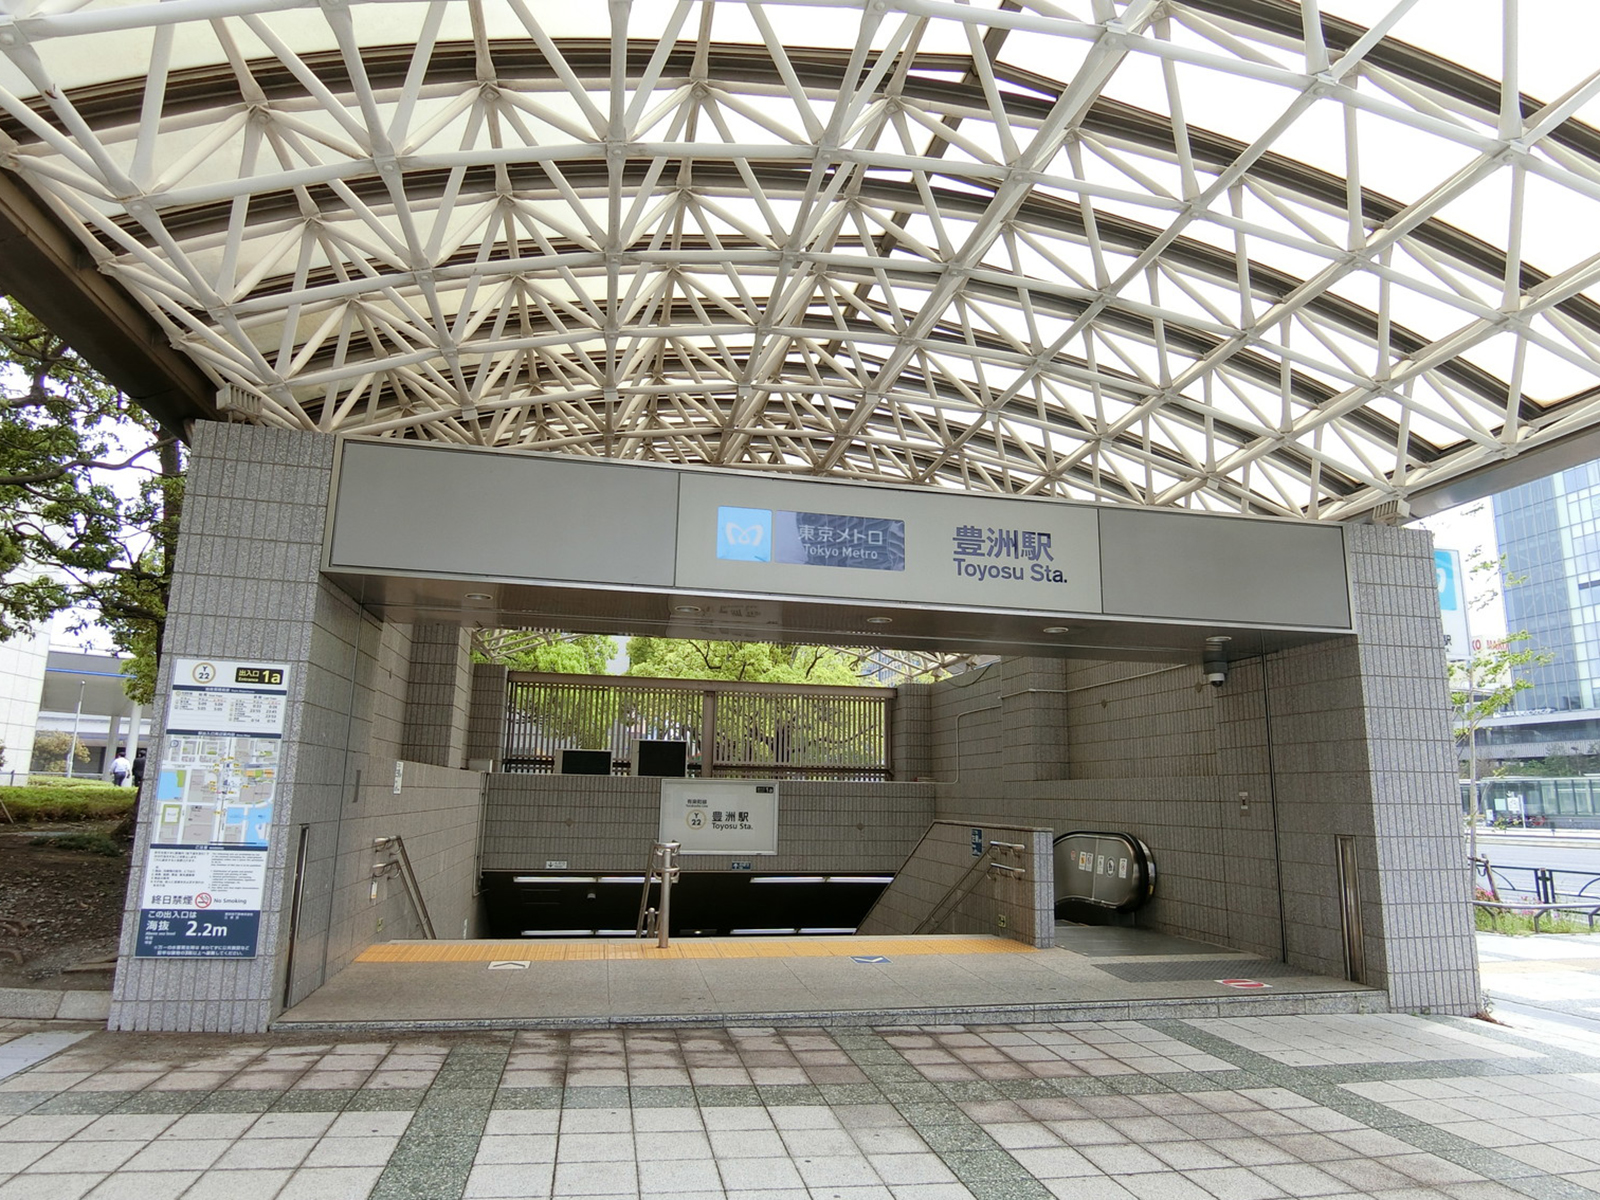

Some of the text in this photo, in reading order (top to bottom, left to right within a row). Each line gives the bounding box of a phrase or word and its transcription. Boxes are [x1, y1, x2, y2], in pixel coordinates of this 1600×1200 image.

[798, 524, 883, 545] 東京メトロ
[952, 525, 1054, 562] 豊洲駅
[803, 543, 878, 560] Tokyo Metro
[953, 558, 1068, 583] Toyosu Sta.
[198, 672, 210, 680] 22
[238, 669, 260, 677] 出入口
[262, 670, 281, 684] 1a
[712, 811, 749, 822] 豊洲駅
[712, 822, 738, 831] Toyosu
[151, 895, 193, 905] 終日禁煙
[148, 911, 197, 919] この出入口は
[146, 920, 228, 937] 海抜 2.2m
